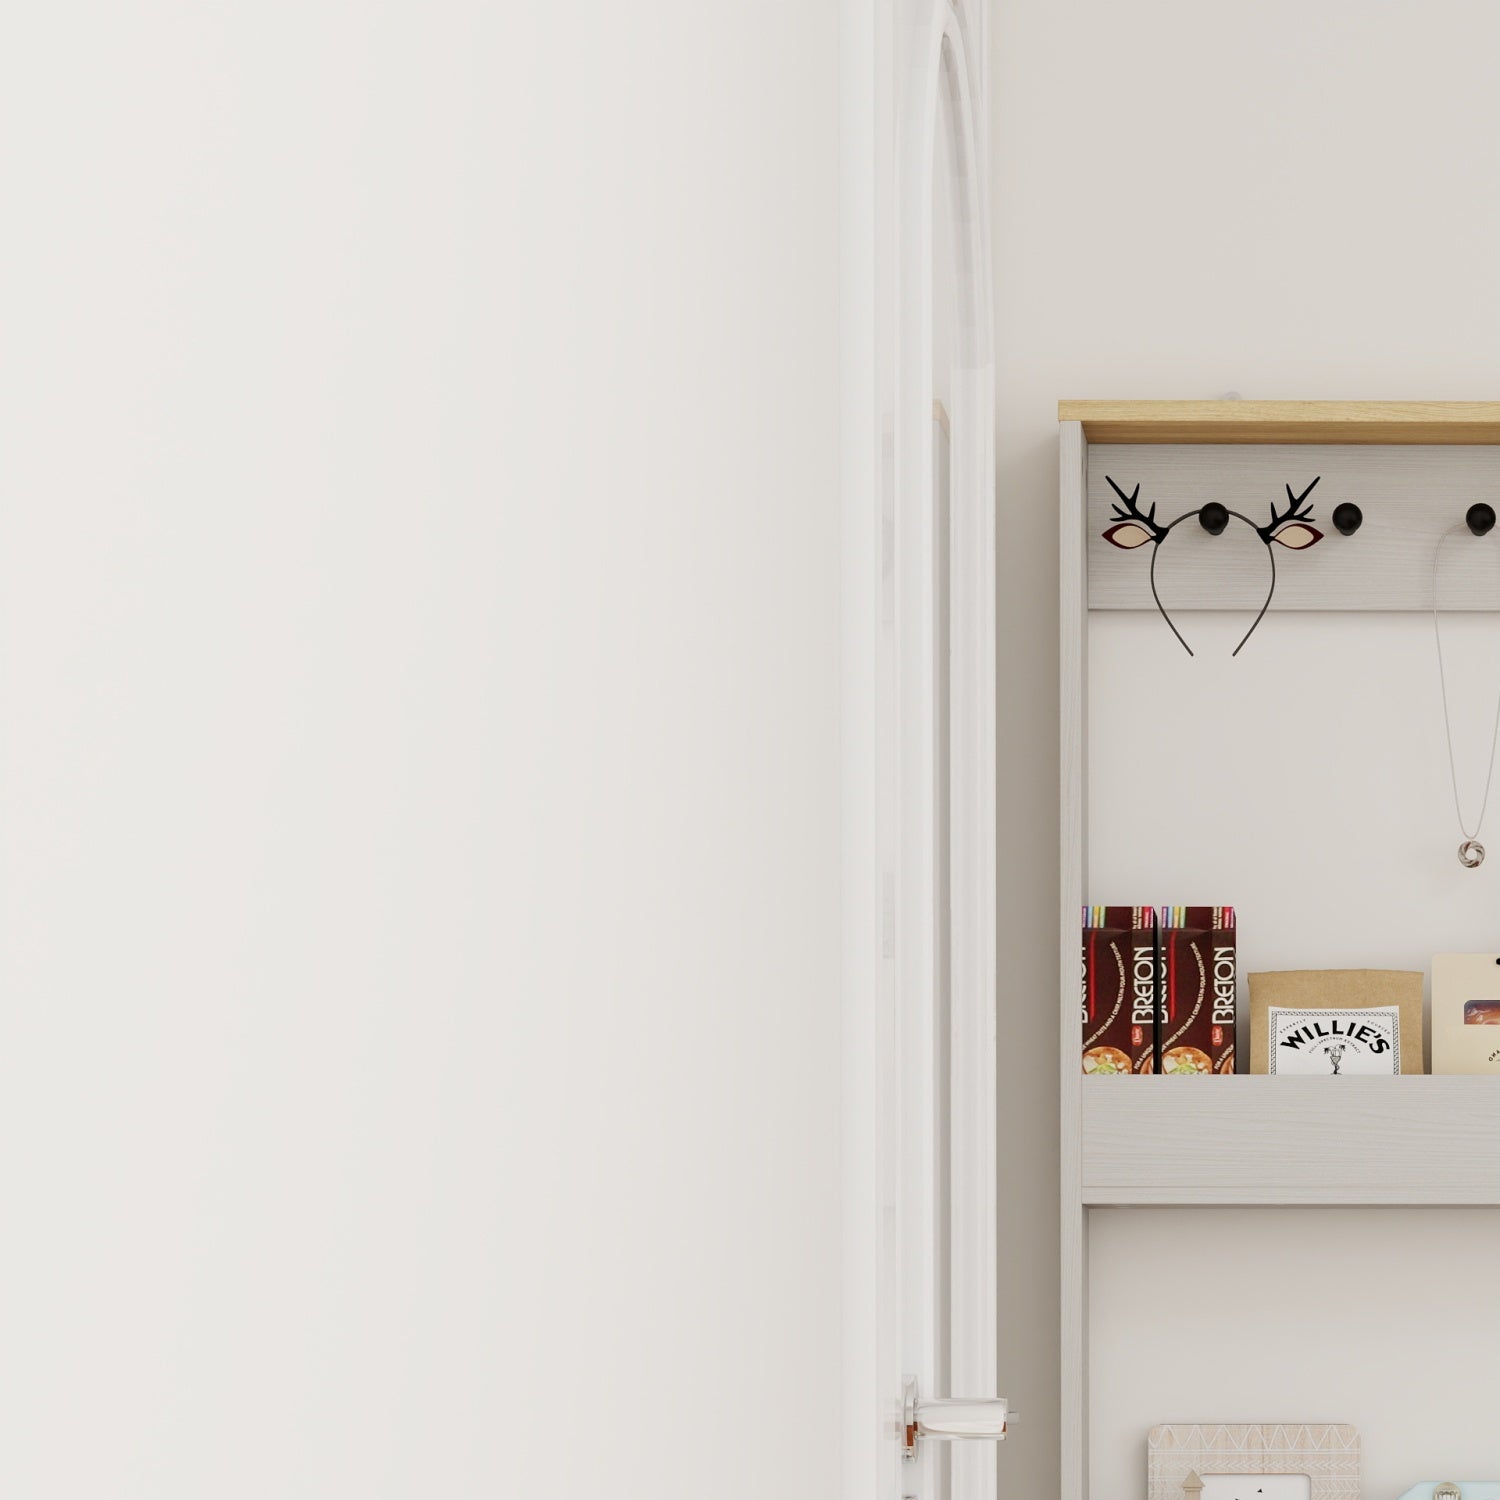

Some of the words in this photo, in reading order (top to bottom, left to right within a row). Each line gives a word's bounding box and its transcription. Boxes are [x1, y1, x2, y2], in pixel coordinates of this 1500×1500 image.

[1131, 947, 1154, 1024] BRETON
[1211, 947, 1234, 1024] BRETON
[1280, 1020, 1390, 1054] WILLIE'S
